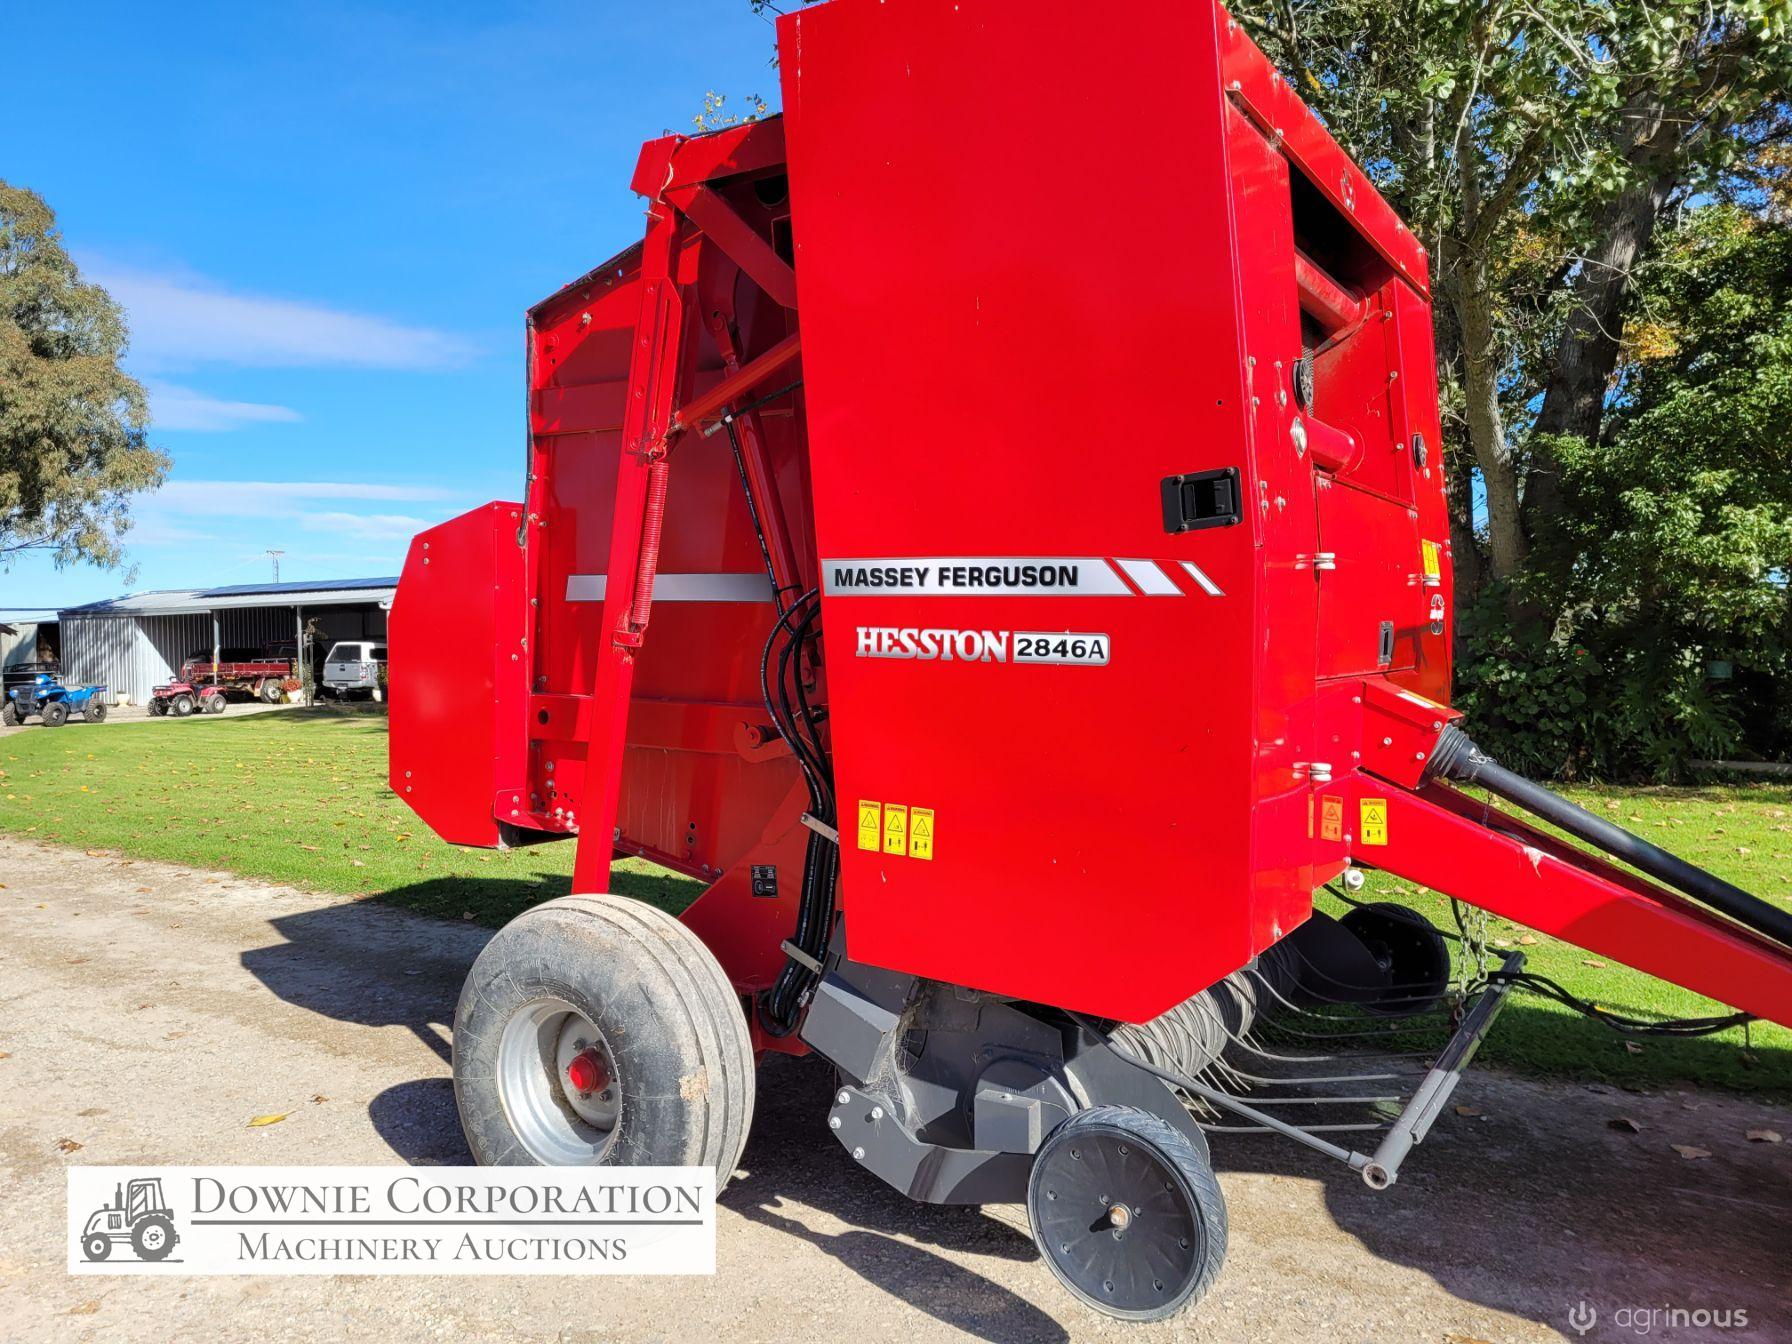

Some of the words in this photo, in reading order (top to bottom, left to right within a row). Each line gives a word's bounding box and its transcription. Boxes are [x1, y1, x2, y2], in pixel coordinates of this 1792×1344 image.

[834, 567, 929, 587] MASSEY
[938, 565, 1078, 587] FERGUSON
[856, 627, 1010, 662] HESSTON
[1017, 638, 1106, 660] 2846A
